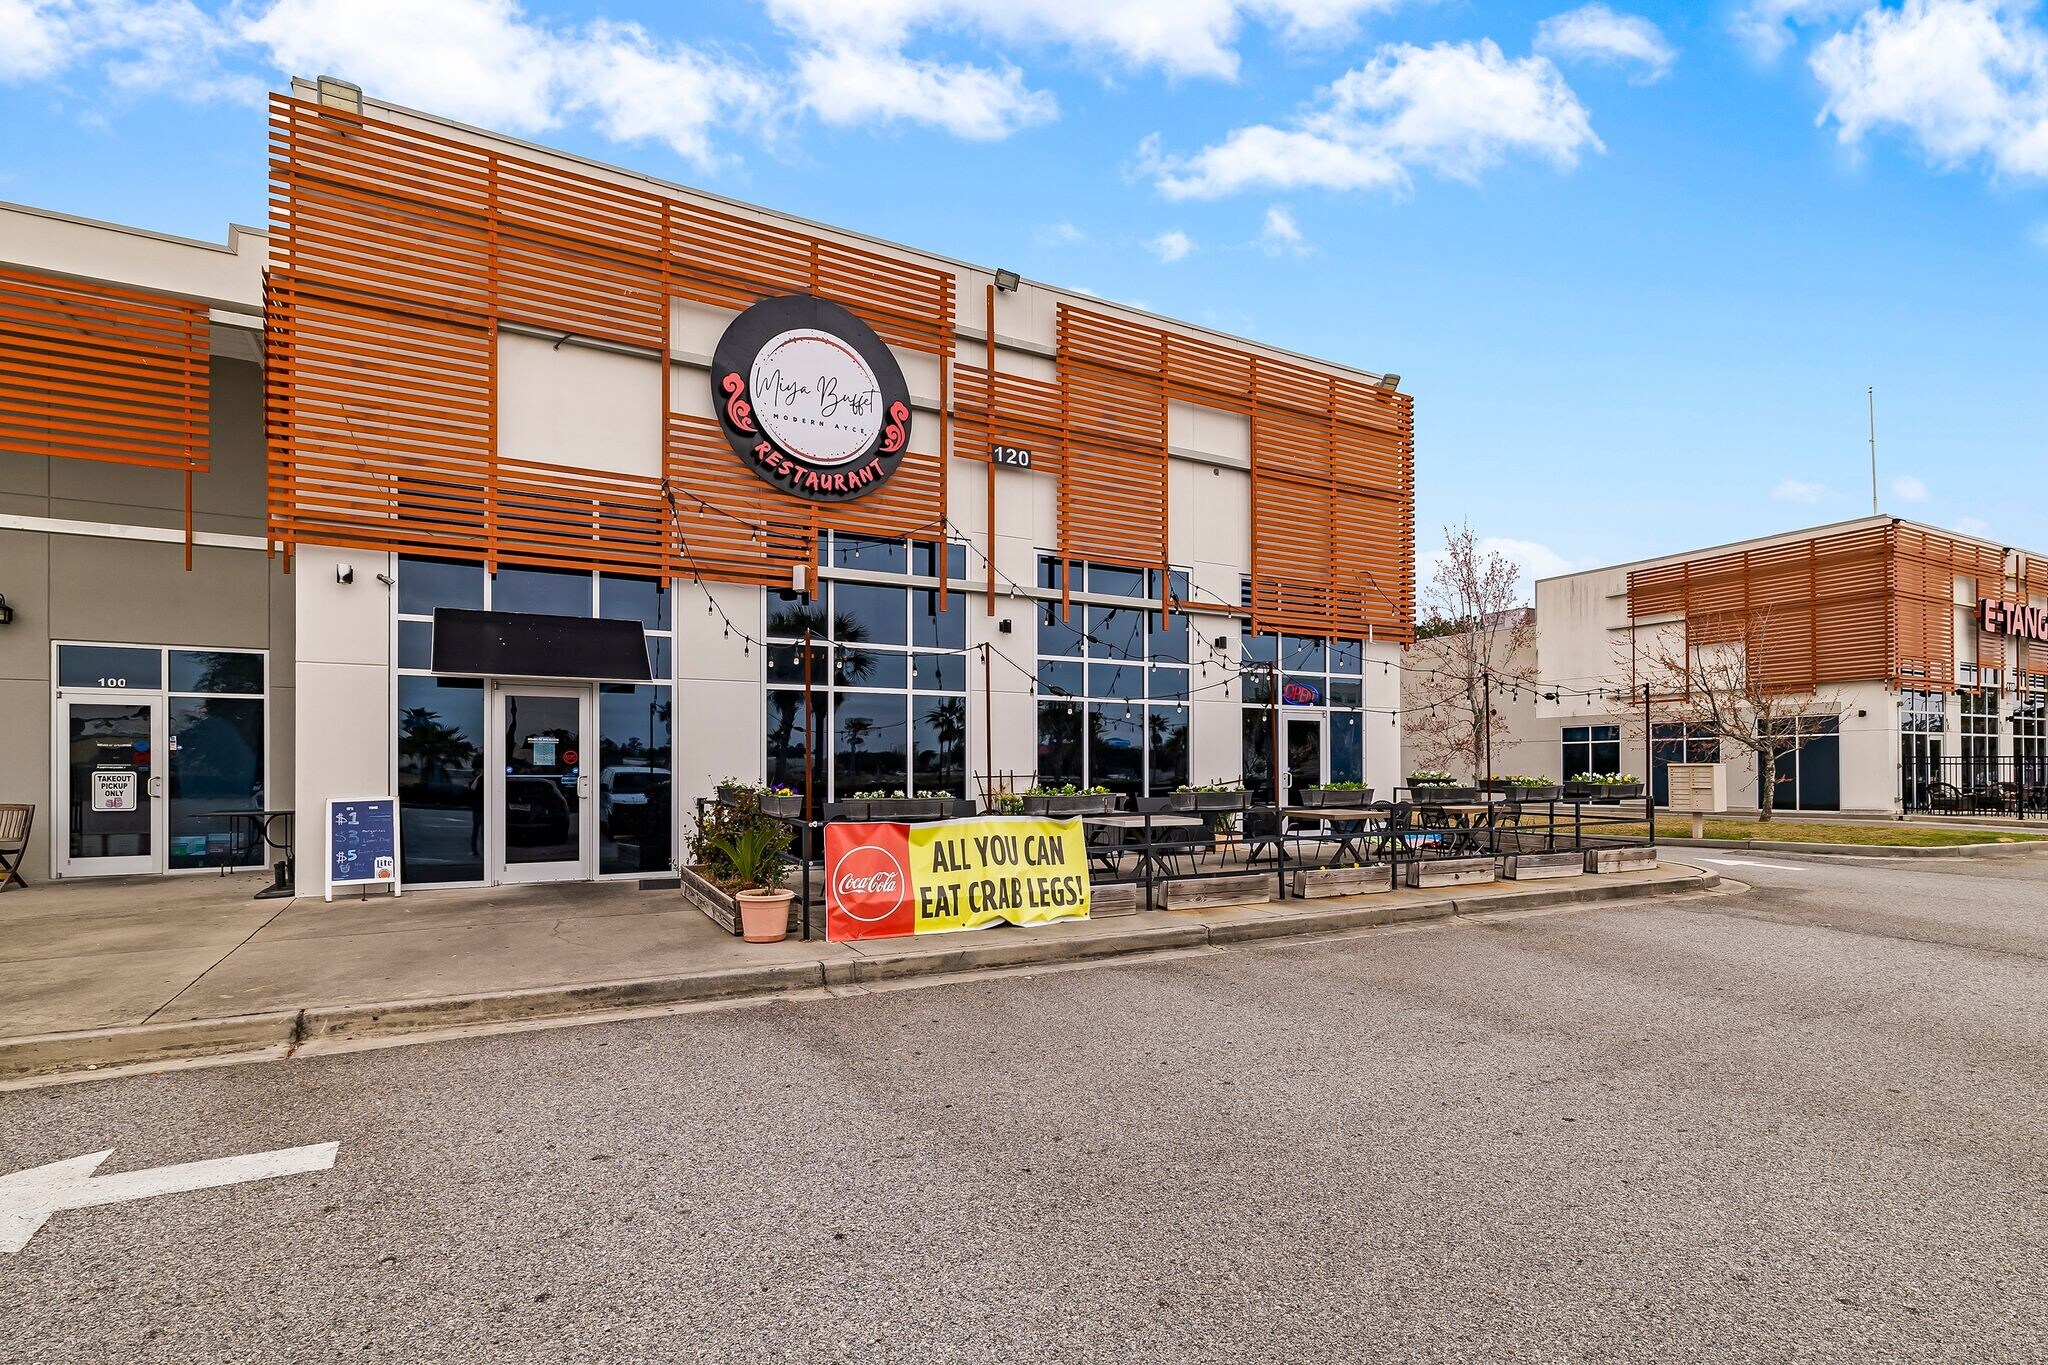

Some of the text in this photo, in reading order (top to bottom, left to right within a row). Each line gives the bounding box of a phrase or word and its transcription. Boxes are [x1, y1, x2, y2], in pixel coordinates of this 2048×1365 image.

[755, 367, 881, 418] Miya Buffet
[773, 413, 825, 427] MODERN
[754, 440, 885, 492] RESTAURANT
[994, 446, 1029, 466] 120
[98, 678, 126, 687] 100
[1284, 683, 1315, 703] OPEN
[97, 775, 131, 783] TAKEOUT
[932, 834, 1065, 873] ALL YOU CAN
[838, 871, 899, 895] Coca-Cola
[919, 875, 1085, 918] EAT CRAB LEGS!
